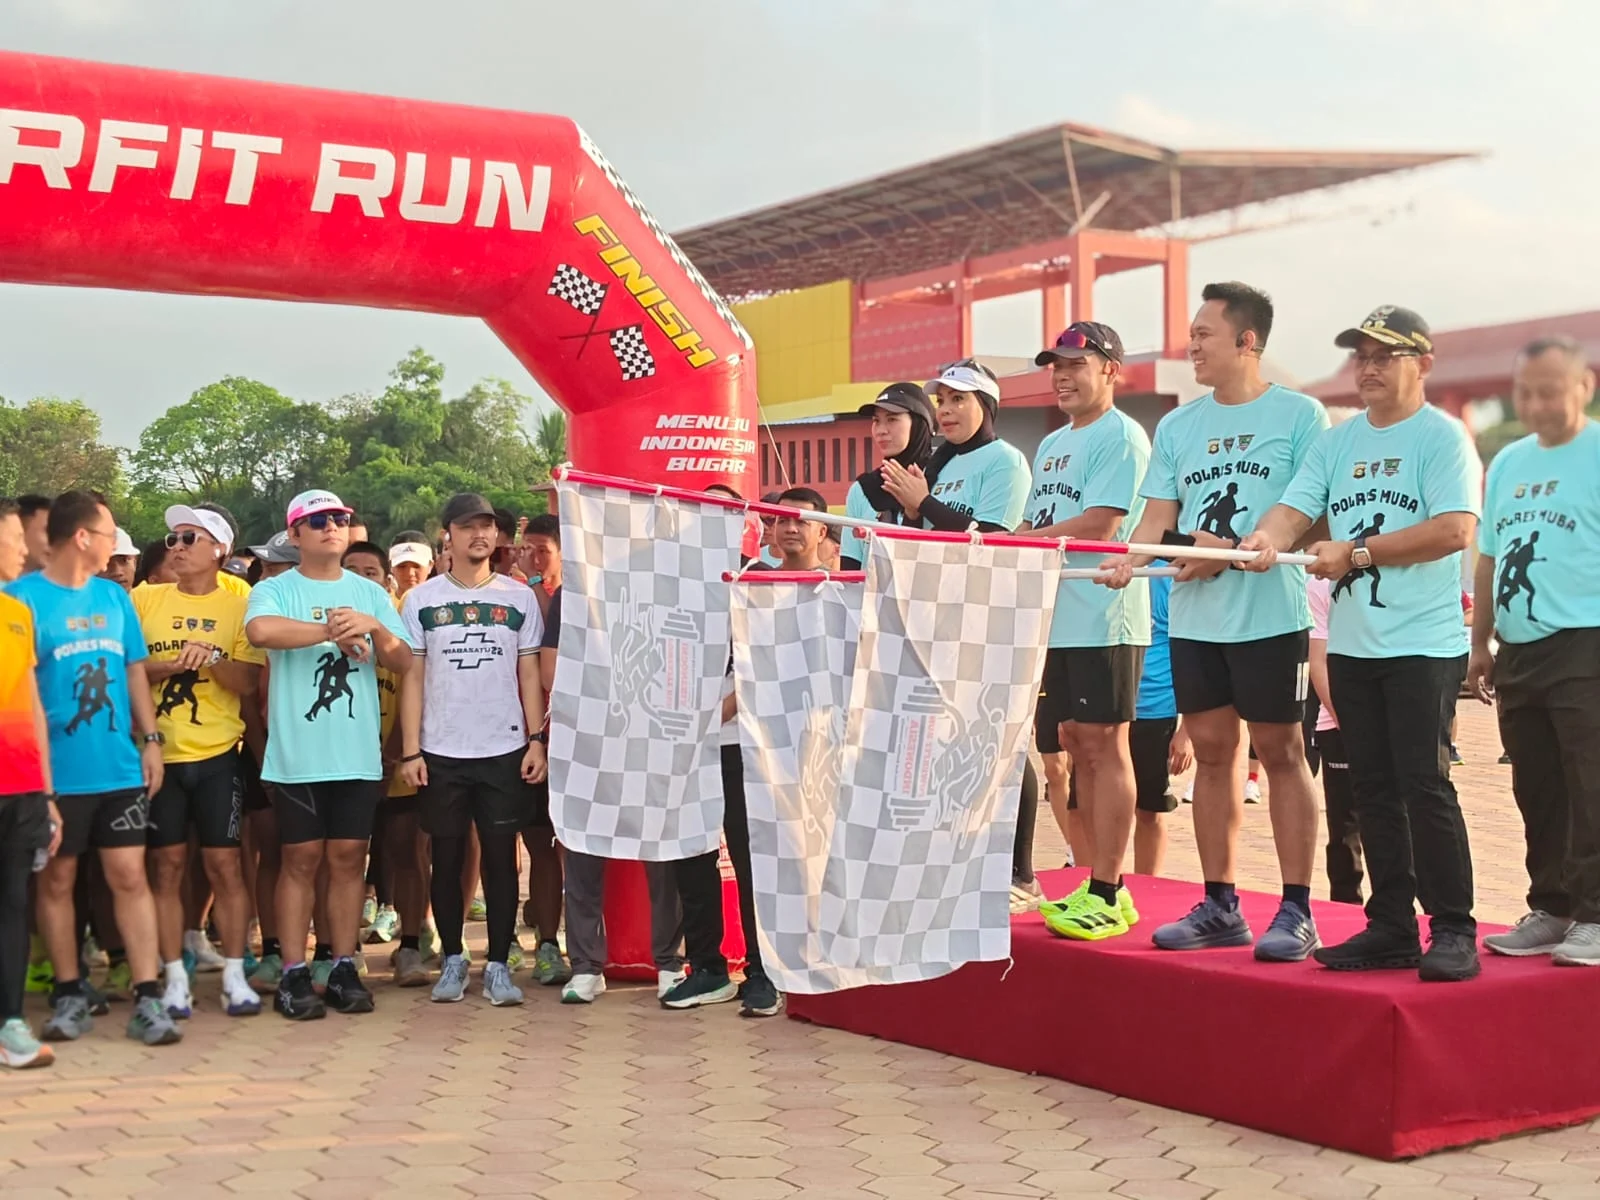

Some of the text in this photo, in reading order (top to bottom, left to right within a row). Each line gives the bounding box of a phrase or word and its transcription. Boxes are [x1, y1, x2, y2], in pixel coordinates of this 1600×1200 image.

[310, 143, 552, 233] RUN
[573, 213, 718, 369] FINISH
[655, 414, 750, 432] MENUJU
[640, 436, 756, 454] INDONESIA
[666, 457, 747, 473] BUGAR
[1184, 463, 1233, 488] POLRS
[1330, 489, 1418, 517] POLRS MUBA
[148, 640, 188, 655] POLR
